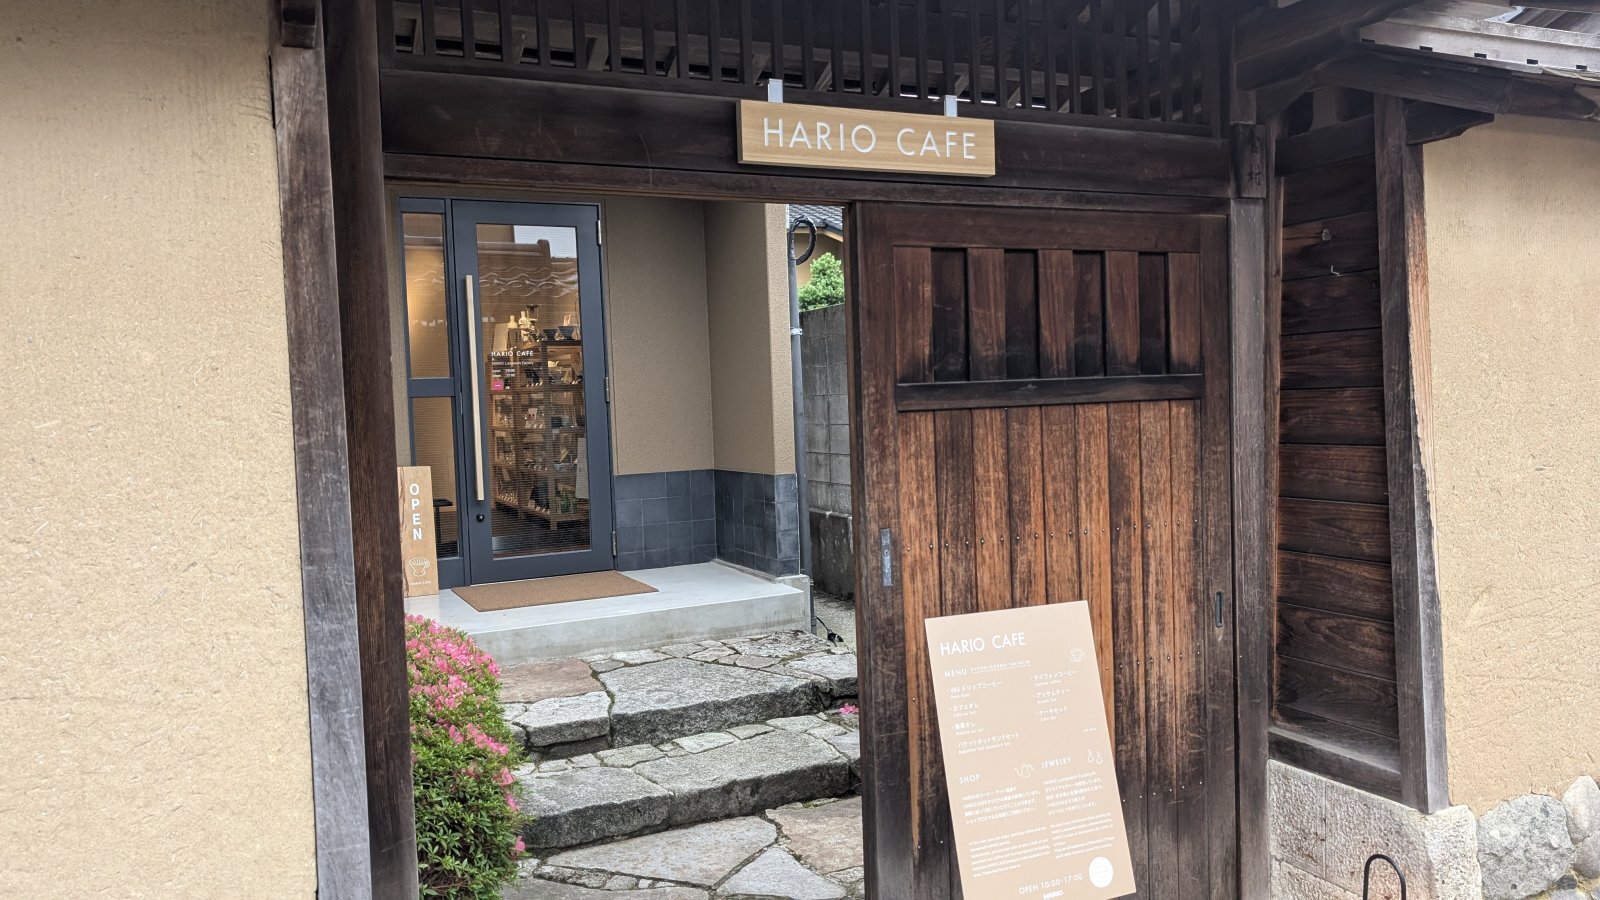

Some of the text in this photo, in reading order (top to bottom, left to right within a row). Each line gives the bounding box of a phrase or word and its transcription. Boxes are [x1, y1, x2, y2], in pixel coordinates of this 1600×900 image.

[763, 117, 976, 160] HARIO CAFE
[409, 483, 423, 541] OPEN
[939, 632, 1026, 657] HARIO CAFE
[944, 668, 968, 679] MENU
[1040, 755, 1072, 769] JEWELRY
[958, 773, 981, 785] SHOP
[1018, 884, 1039, 895] OPEN
